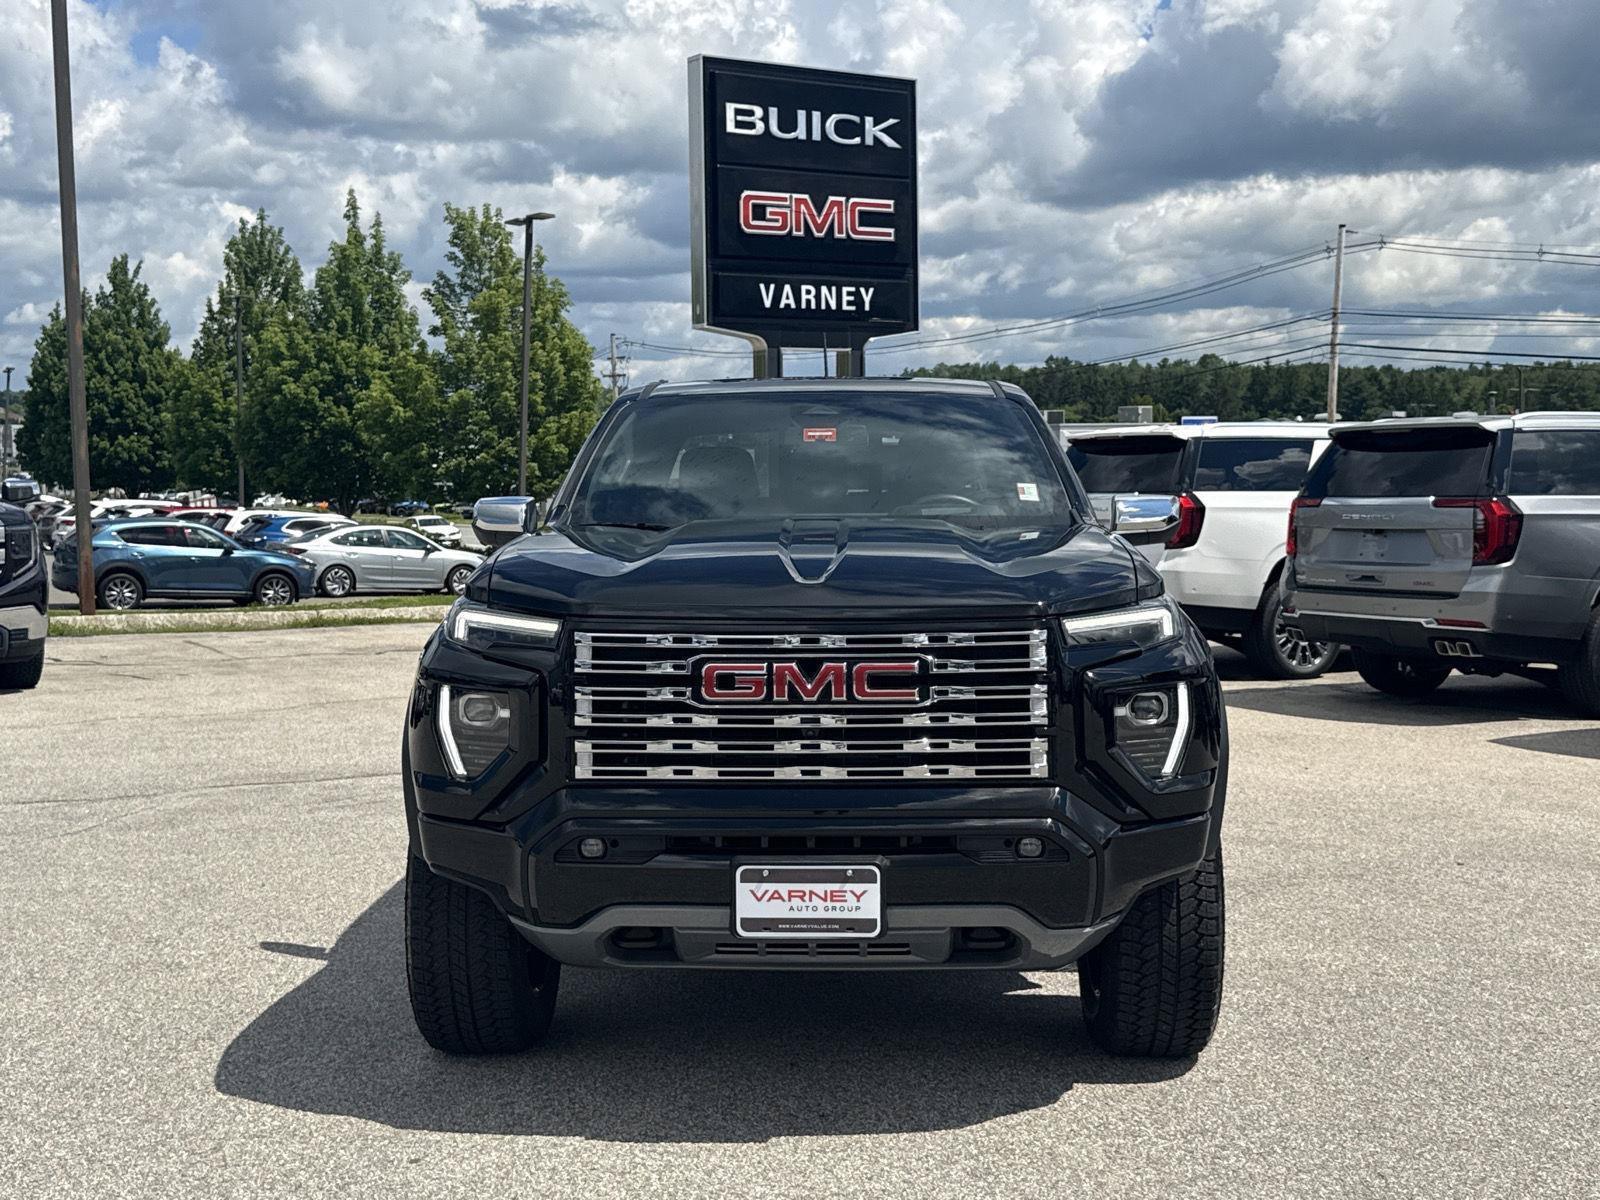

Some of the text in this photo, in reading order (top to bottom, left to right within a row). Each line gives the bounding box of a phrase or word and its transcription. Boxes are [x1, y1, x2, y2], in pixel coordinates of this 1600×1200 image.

[725, 102, 902, 148] BUICK
[739, 190, 895, 241] GMC
[759, 283, 875, 311] VARNEY
[701, 661, 919, 701] GMC
[749, 889, 868, 902] VARNEY
